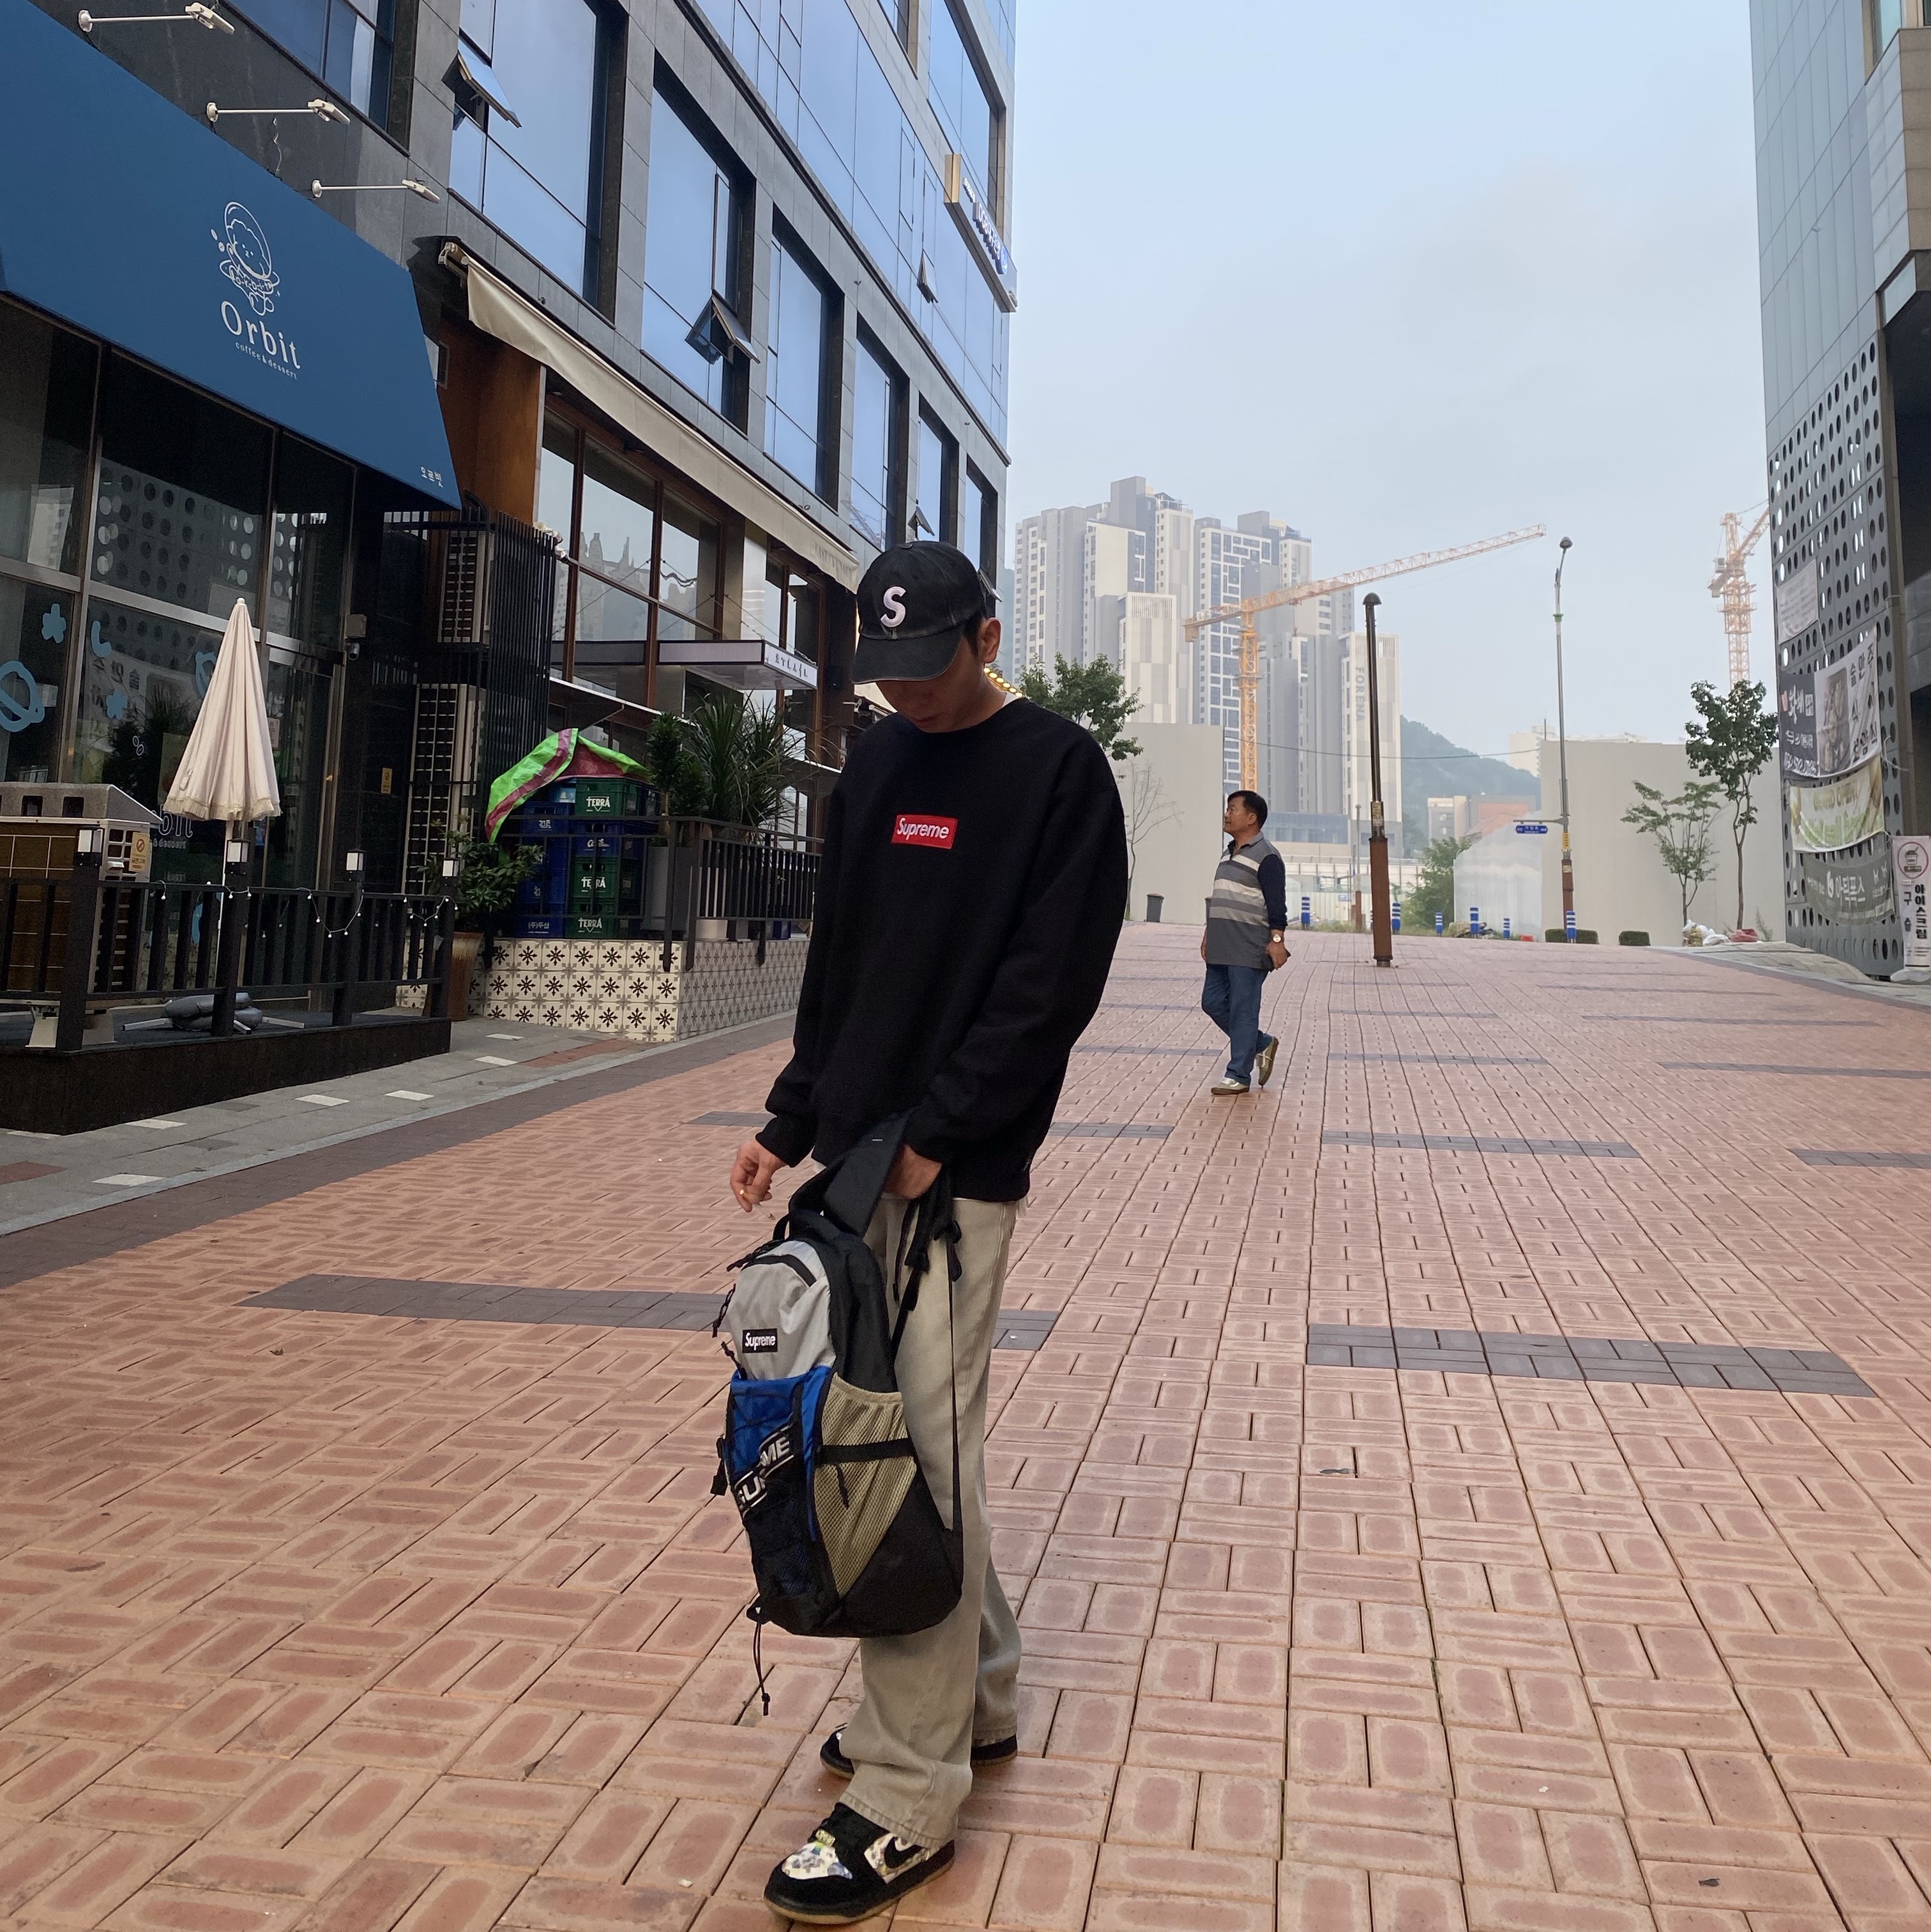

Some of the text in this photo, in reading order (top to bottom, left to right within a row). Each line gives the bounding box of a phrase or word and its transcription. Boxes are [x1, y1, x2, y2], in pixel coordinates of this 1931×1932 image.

[221, 301, 300, 369] Orbit
[421, 466, 443, 488] 오르빗
[880, 586, 907, 628] S
[1355, 667, 1365, 722] FORENA
[586, 796, 610, 808] TERRA
[897, 818, 950, 840] Supreme
[581, 877, 606, 889] TERA
[1914, 884, 1928, 939] 아이스크림
[578, 918, 603, 929] TERRA
[745, 1332, 776, 1351] Supreme
